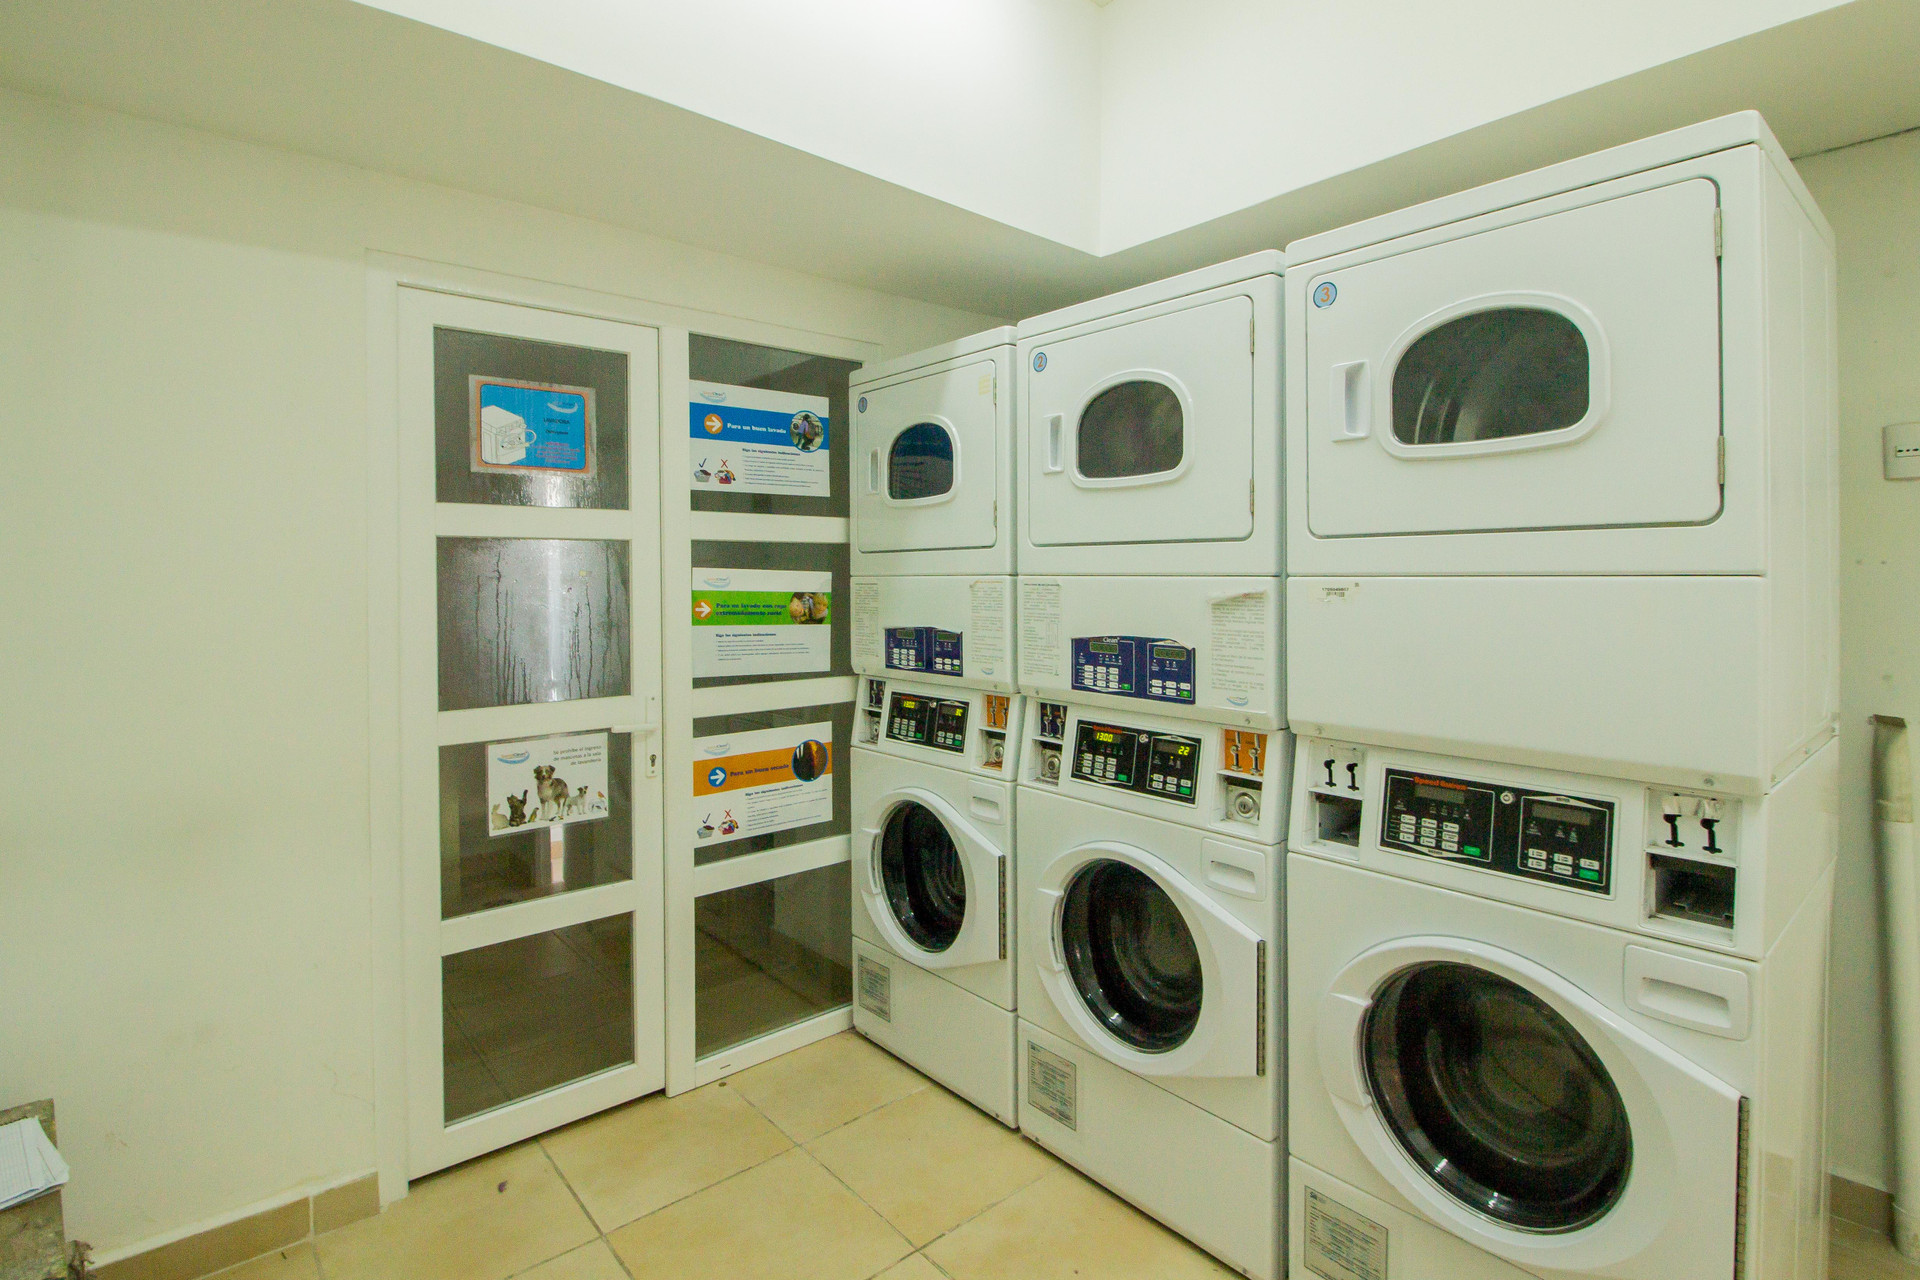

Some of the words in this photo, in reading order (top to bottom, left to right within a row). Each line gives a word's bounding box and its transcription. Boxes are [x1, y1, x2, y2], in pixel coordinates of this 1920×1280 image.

[1320, 286, 1331, 303] 3
[1036, 355, 1044, 369] 2
[1096, 732, 1114, 743] 1300
[1178, 745, 1190, 756] 22
